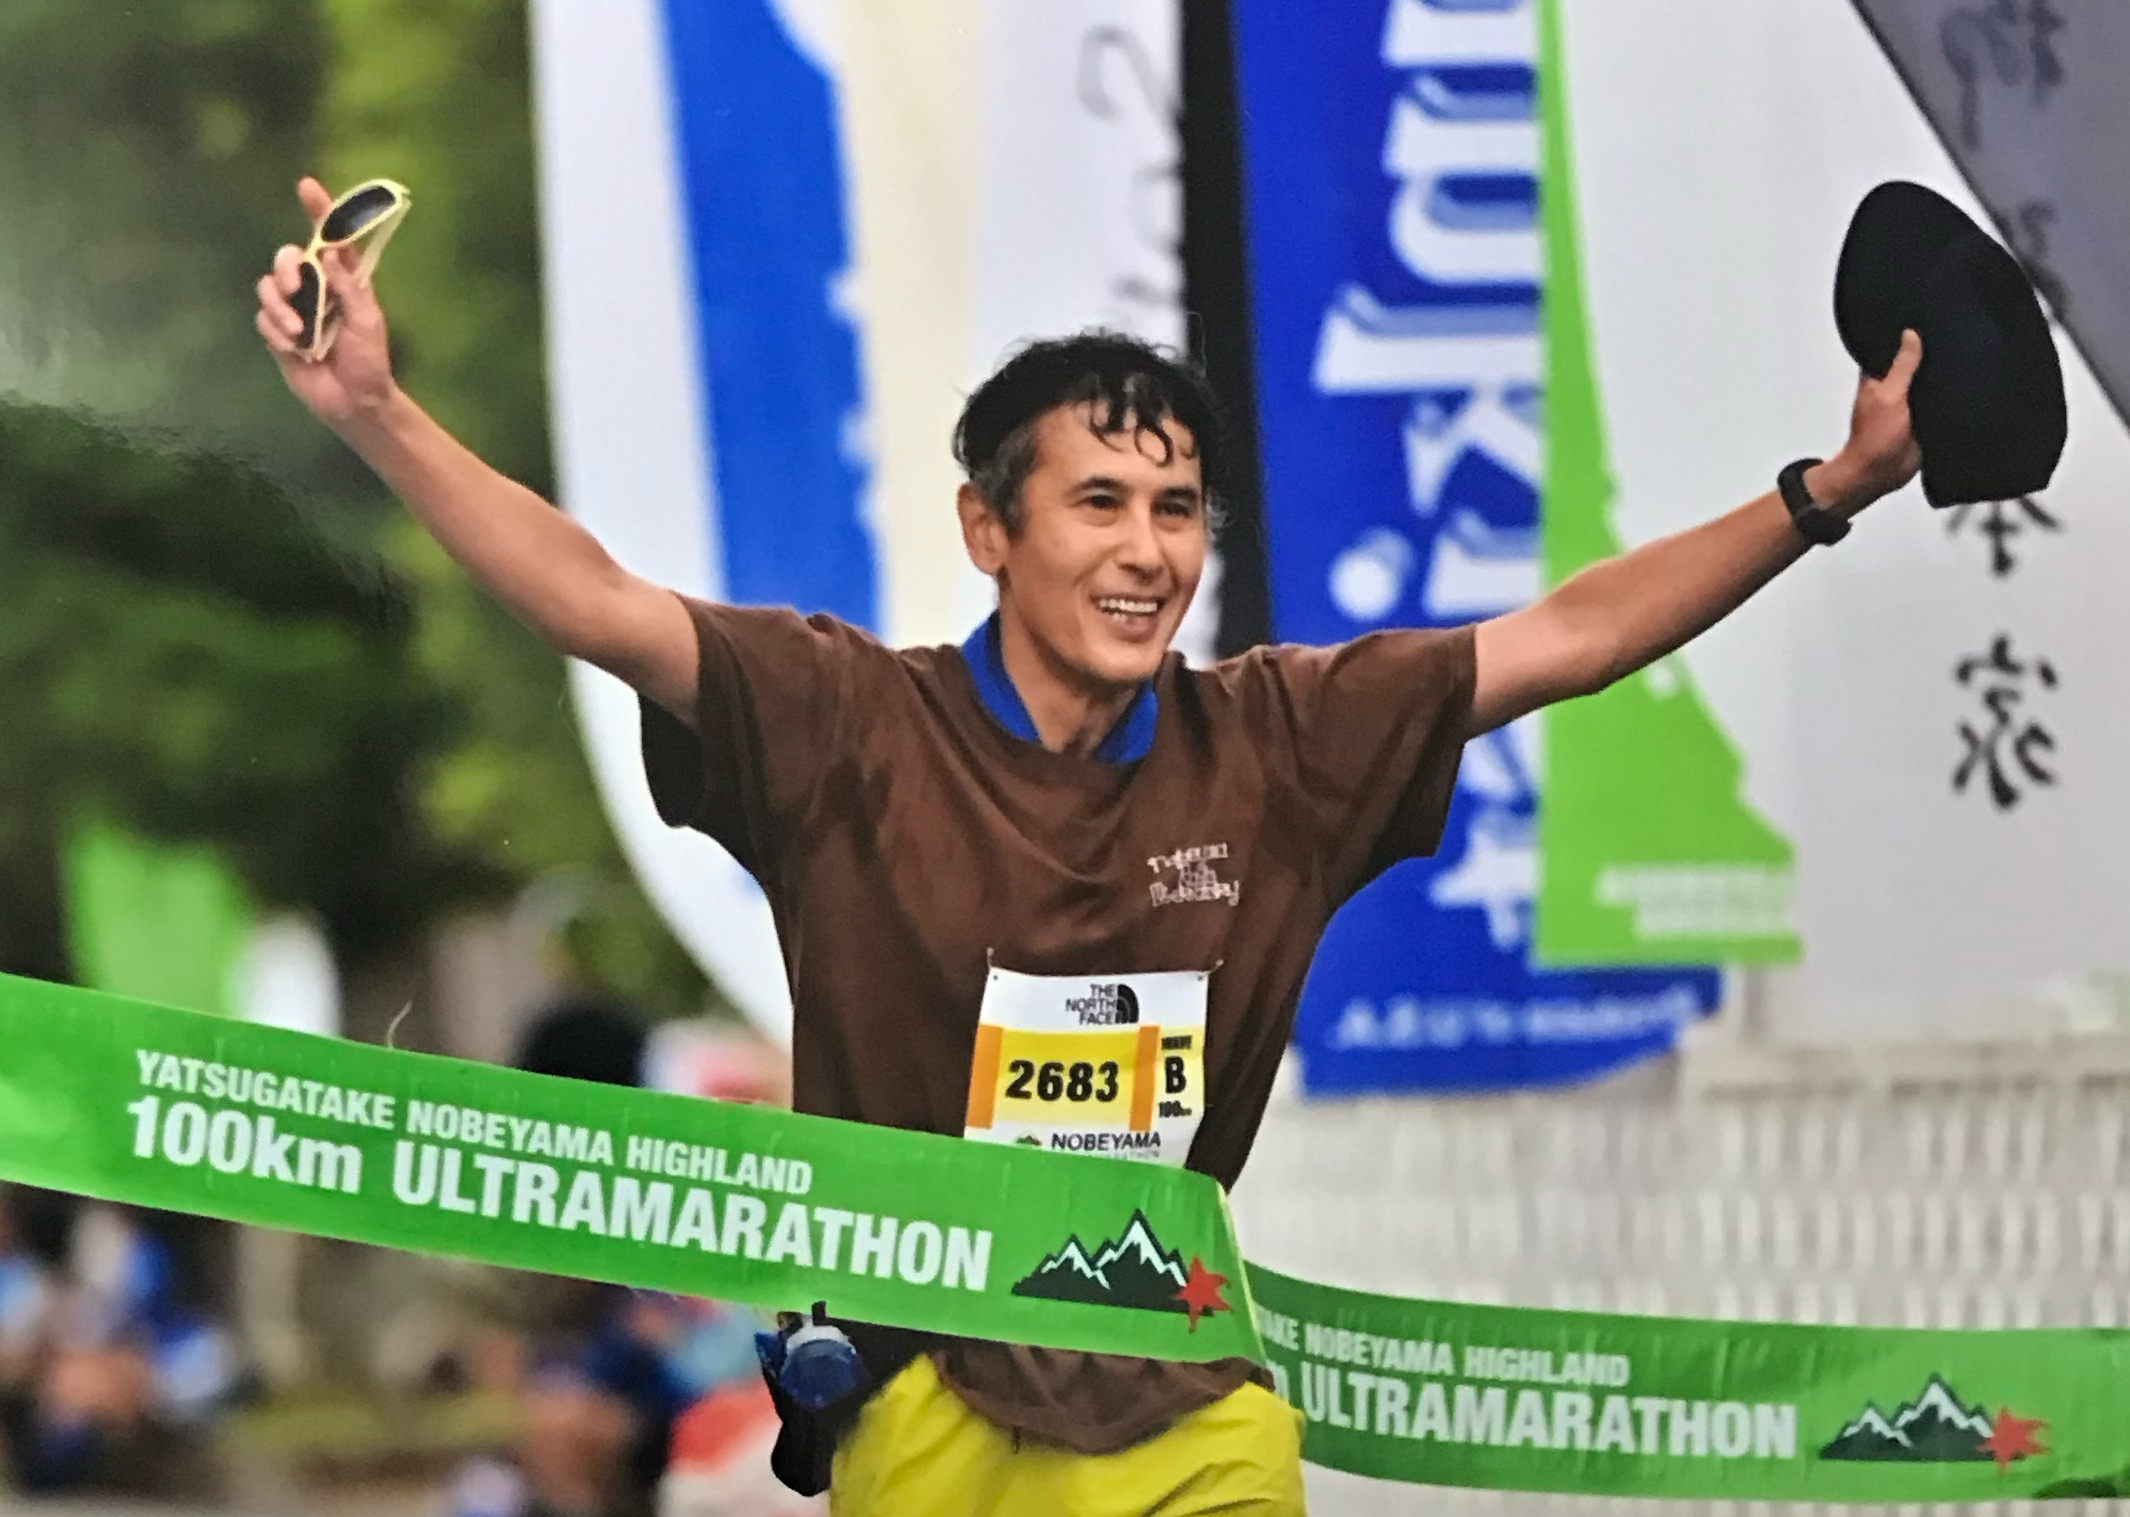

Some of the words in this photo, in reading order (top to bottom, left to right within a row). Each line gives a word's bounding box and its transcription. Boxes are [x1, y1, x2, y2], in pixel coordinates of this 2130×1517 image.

[1065, 998, 1116, 1012] NORTH
[1089, 983, 1116, 998] THE
[1079, 1011, 1115, 1026] FACE
[1005, 1059, 1119, 1102] 2683
[1164, 1055, 1187, 1094] B
[136, 1049, 396, 1130] YATSUGATAKE
[406, 1099, 613, 1166] NOBEYAMA
[626, 1135, 812, 1195] HIGHLAND
[1051, 1131, 1162, 1151] NOBEYAMA
[127, 1095, 363, 1195] 100km
[393, 1139, 993, 1292] ULTRAMARATHON
[1304, 1322, 1453, 1376] NOBEYAMA
[1463, 1344, 1631, 1388] HIGHLAND
[1301, 1360, 1798, 1459] ULTRAMARATHON
